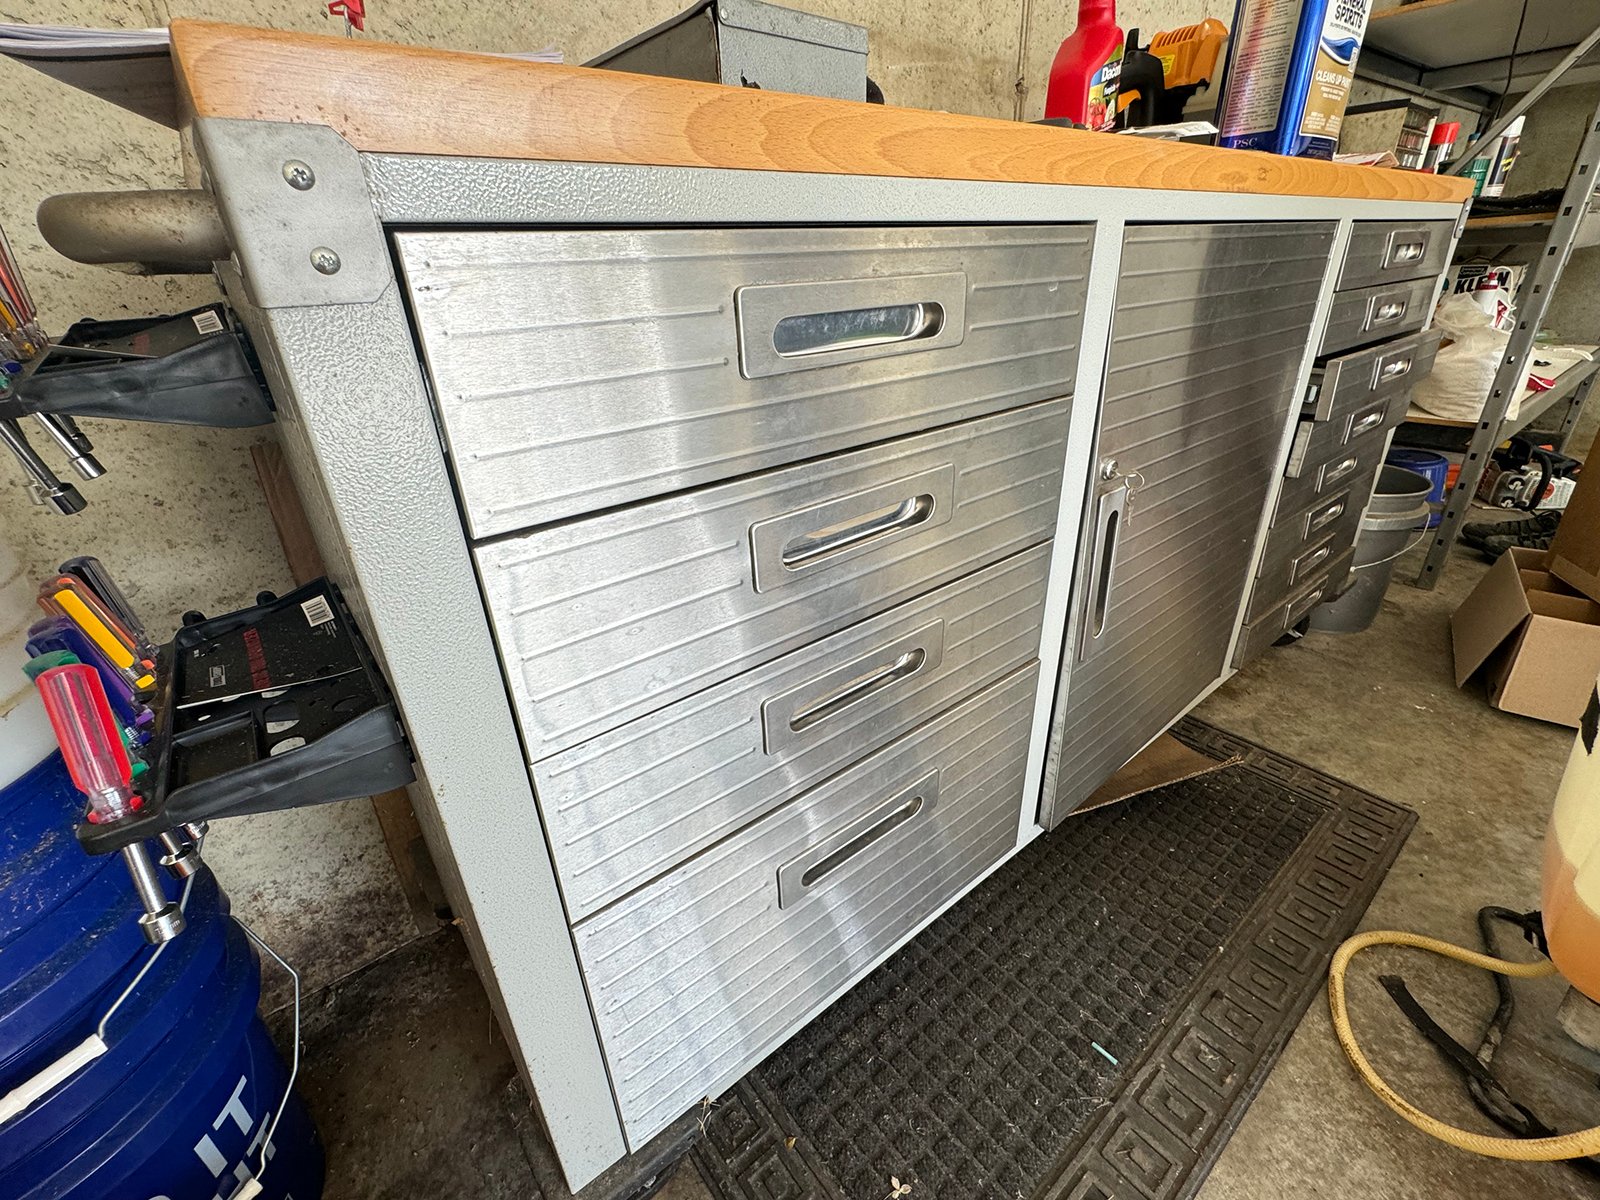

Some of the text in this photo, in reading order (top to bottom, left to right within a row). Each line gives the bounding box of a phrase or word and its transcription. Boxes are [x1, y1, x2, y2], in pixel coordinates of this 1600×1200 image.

[1336, 0, 1366, 14] ERAL
[1334, 4, 1363, 29] SPIRITS
[1315, 70, 1336, 84] CLEANS
[1233, 137, 1258, 148] PSC
[1454, 271, 1510, 294] KLEN
[193, 1074, 254, 1178] IT
